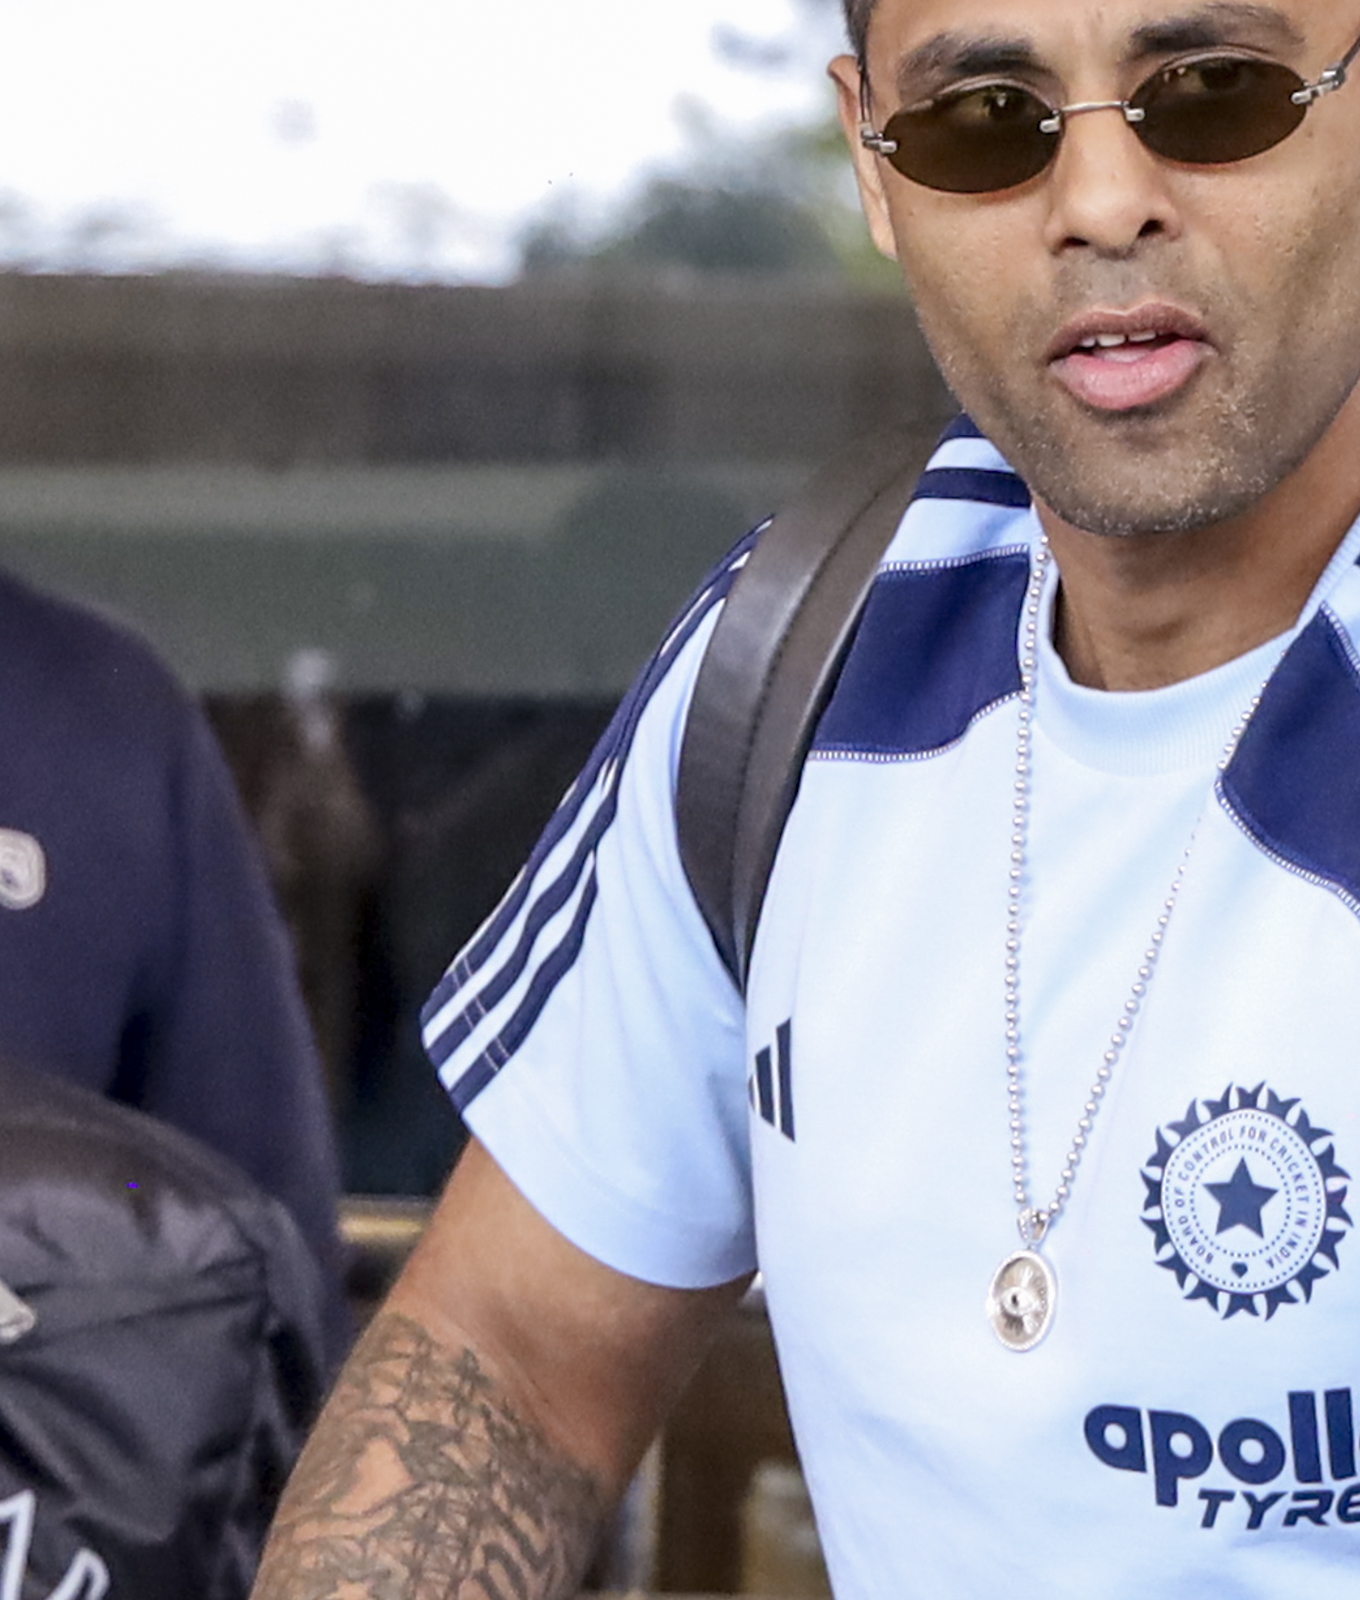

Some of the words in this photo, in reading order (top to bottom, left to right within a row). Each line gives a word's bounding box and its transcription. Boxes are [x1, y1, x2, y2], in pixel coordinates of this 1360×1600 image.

[1240, 1125, 1268, 1144] FOR
[1177, 1128, 1234, 1182] CONTROL
[1269, 1138, 1310, 1204] CRICKET
[1174, 1186, 1186, 1208] OF
[1295, 1210, 1308, 1228] IN
[1178, 1215, 1214, 1265] BOARD
[1265, 1232, 1303, 1269] INDIA
